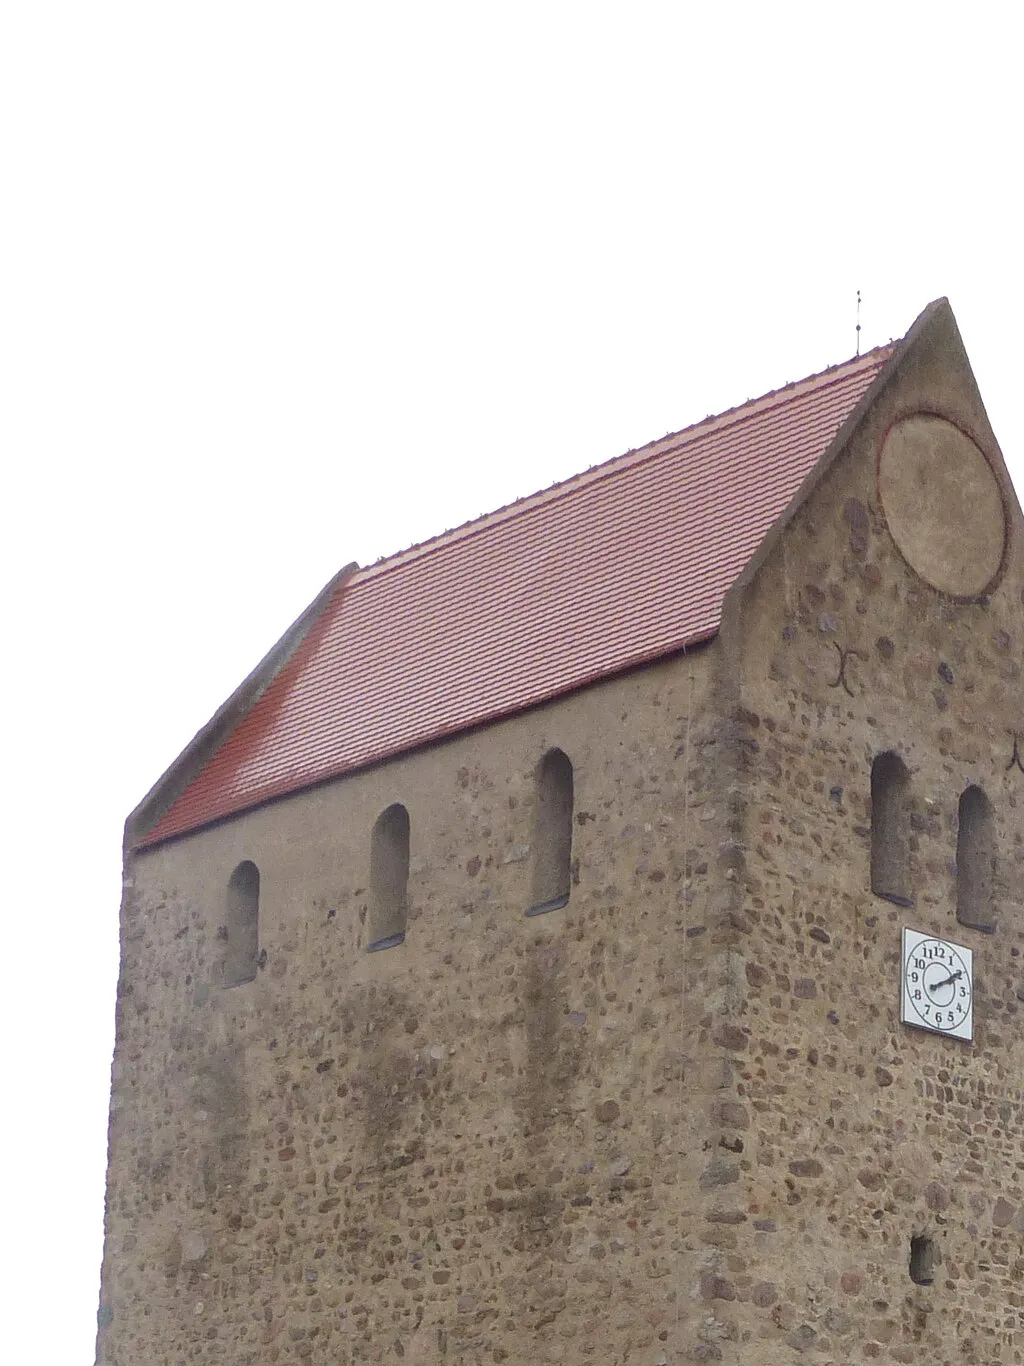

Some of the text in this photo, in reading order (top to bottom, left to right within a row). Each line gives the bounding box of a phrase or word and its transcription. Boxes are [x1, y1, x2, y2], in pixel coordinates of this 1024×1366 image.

[923, 947, 932, 959] 11
[934, 947, 945, 958] 12
[914, 958, 925, 969] 10
[948, 956, 953, 966] 1
[912, 972, 918, 982] 9
[915, 990, 921, 1000] 8
[960, 987, 966, 997] 3
[924, 1004, 930, 1014] 7
[956, 1002, 962, 1013] 4
[936, 1012, 942, 1022] 6
[948, 1012, 954, 1022] 5
